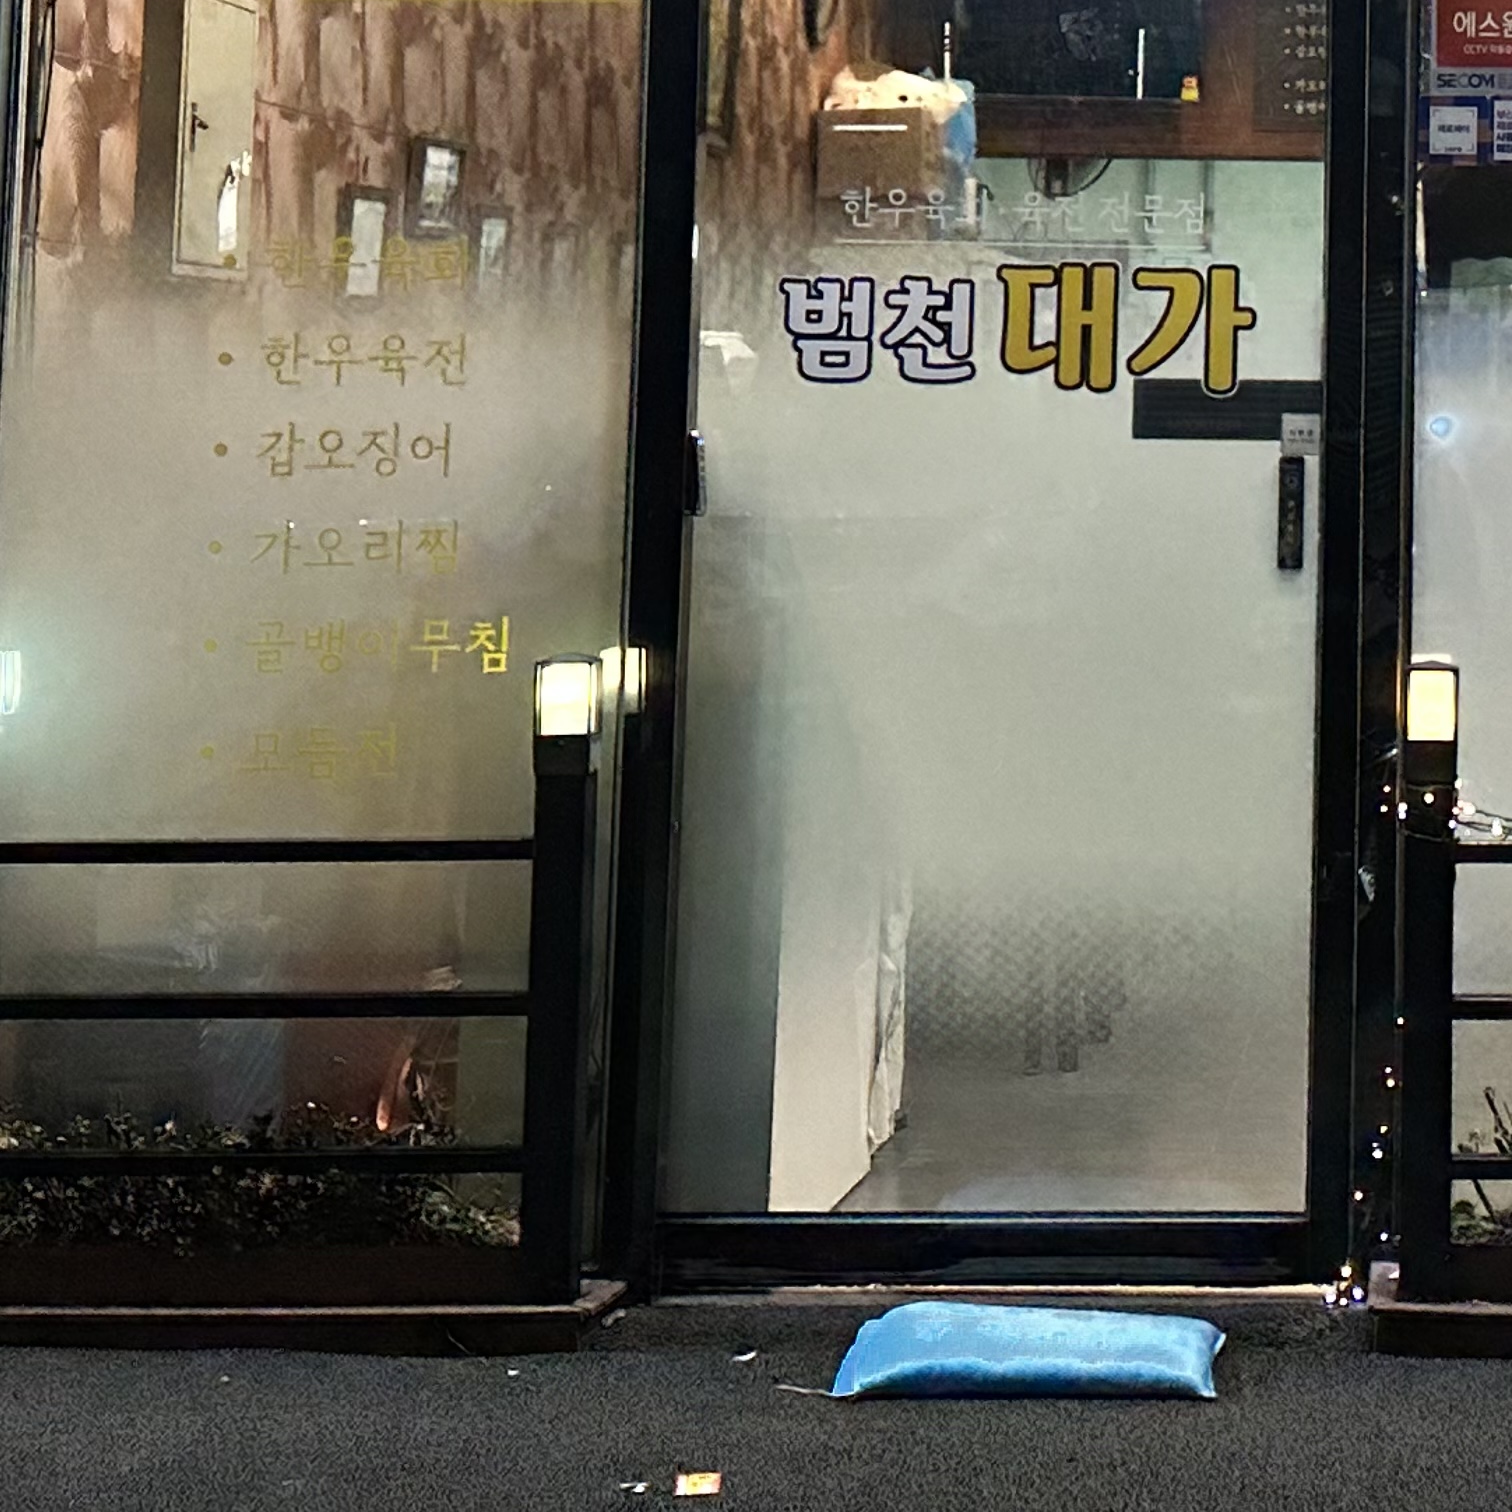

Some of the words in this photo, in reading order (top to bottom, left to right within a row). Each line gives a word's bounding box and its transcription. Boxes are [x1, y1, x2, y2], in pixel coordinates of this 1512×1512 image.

[1098, 191, 1205, 236] 전문점
[780, 274, 976, 384] 범천
[997, 261, 1258, 399] 대가
[259, 332, 468, 387] 한우육전
[256, 420, 452, 478] 갑오징어
[249, 518, 459, 576] 가오리찜
